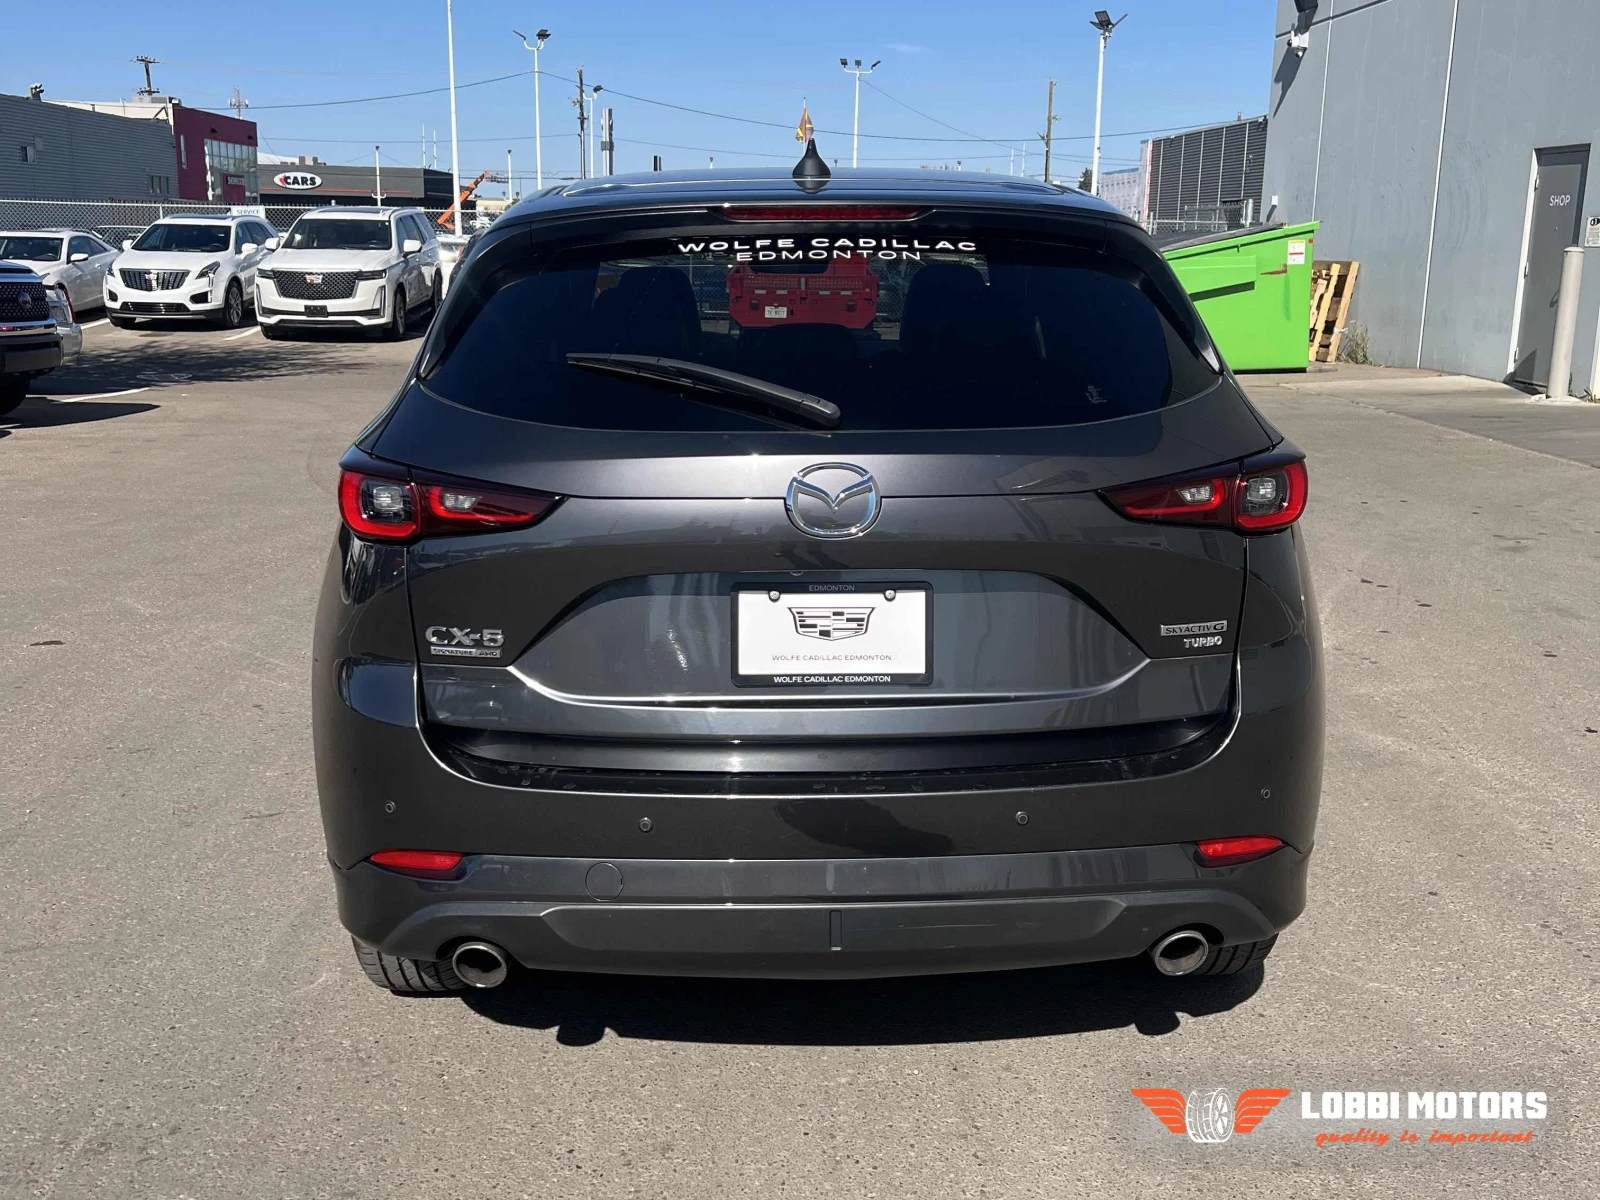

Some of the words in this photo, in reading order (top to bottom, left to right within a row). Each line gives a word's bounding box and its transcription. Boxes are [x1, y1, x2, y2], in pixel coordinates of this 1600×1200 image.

[284, 176, 316, 186] CARS
[1550, 195, 1570, 206] SHOP
[236, 208, 260, 216] SERVICE
[678, 238, 795, 253] WOLFE
[811, 238, 977, 251] CADILLAC
[736, 249, 921, 262] EDMONTON
[808, 584, 855, 592] EDMONTON
[425, 626, 504, 647] CX-5
[1183, 635, 1222, 648] TURBO
[433, 648, 474, 656] SIGNATURE
[773, 675, 803, 684] WOLFE
[803, 675, 844, 684] CADILLAC
[844, 675, 891, 683] EDMONTON
